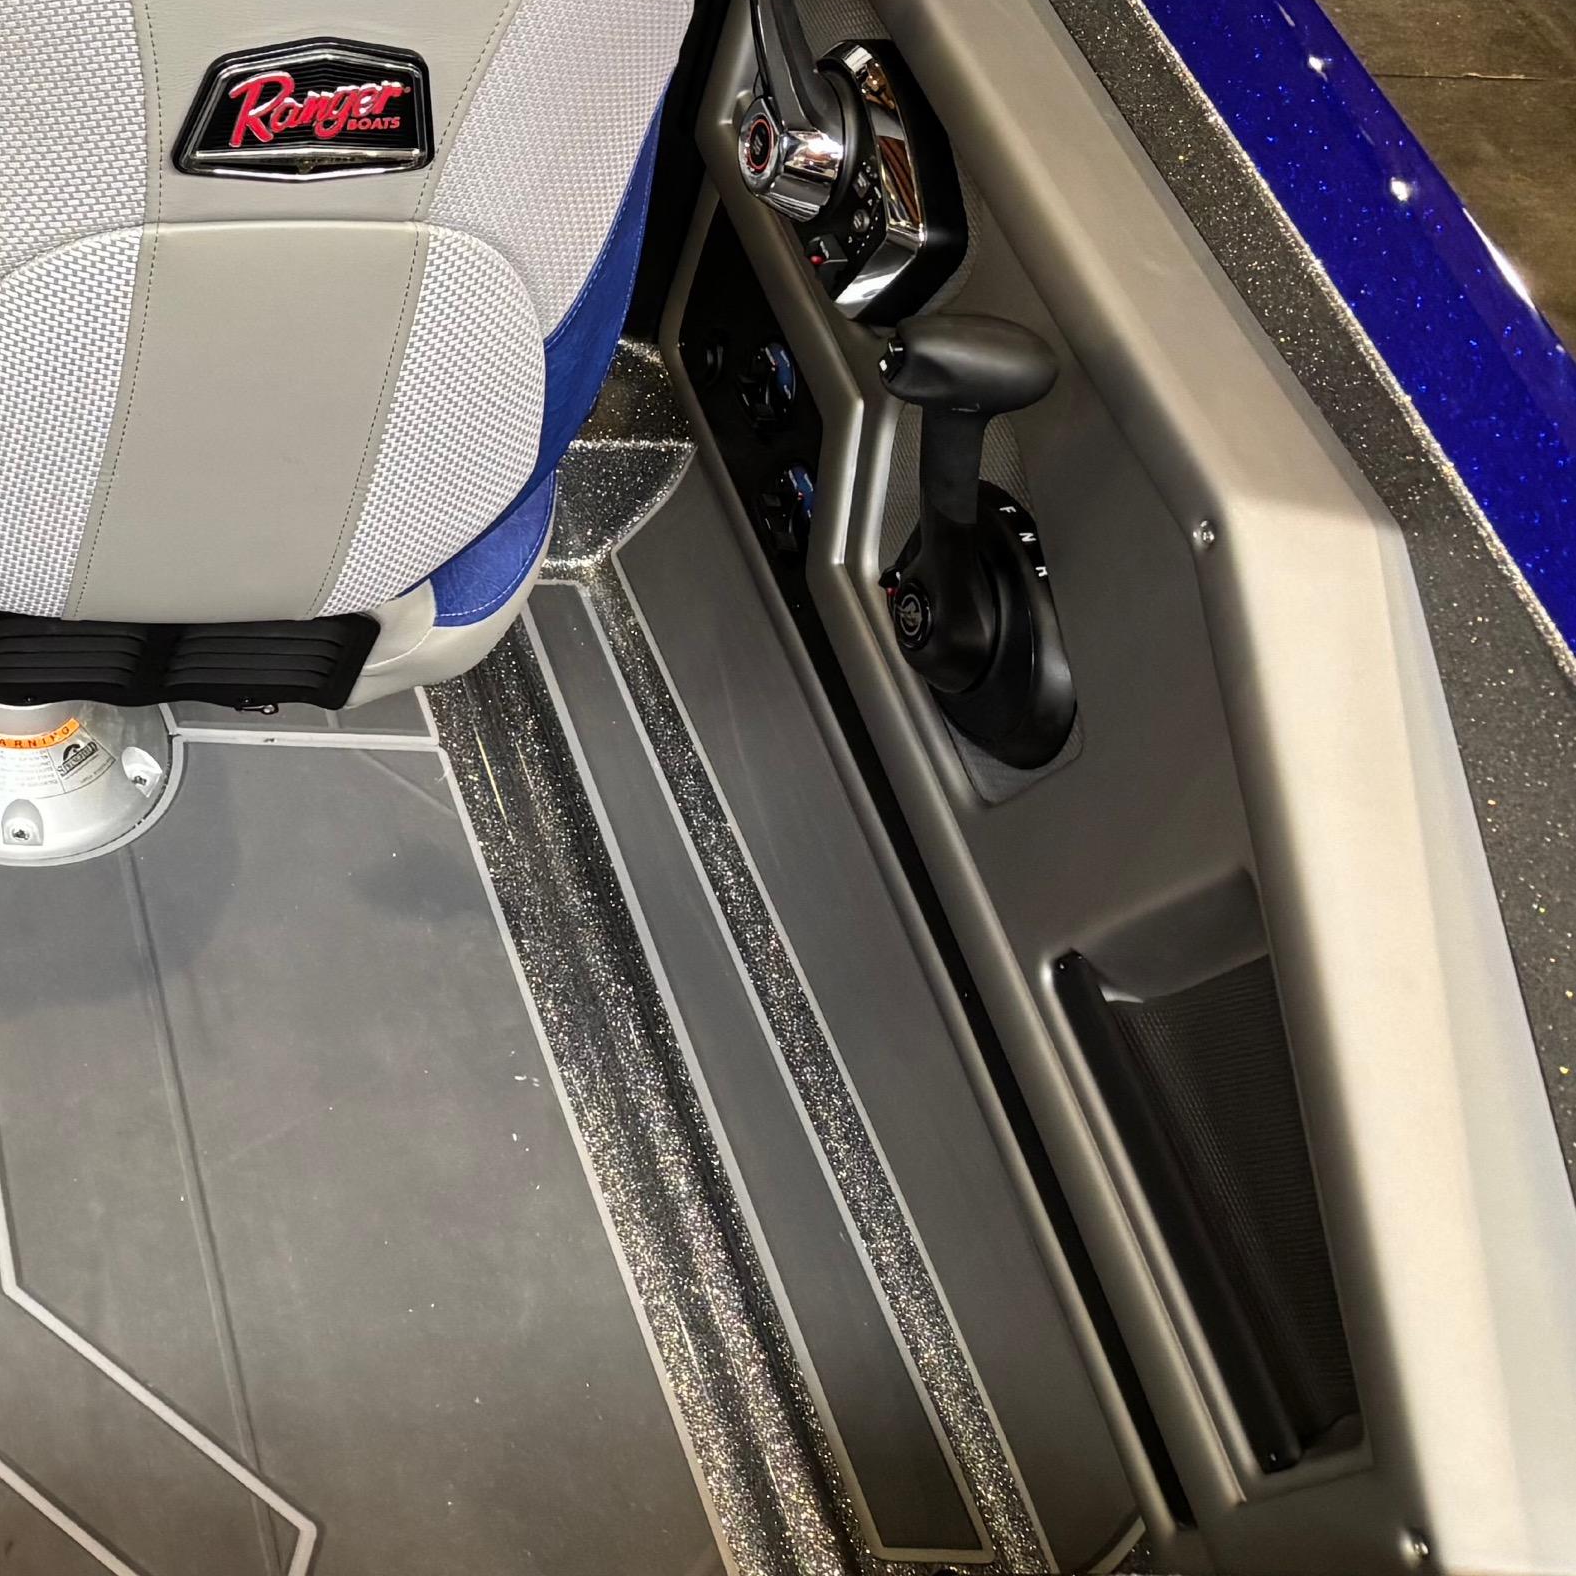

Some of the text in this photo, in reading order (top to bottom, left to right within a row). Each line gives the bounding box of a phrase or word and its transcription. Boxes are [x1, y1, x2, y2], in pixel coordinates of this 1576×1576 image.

[228, 70, 405, 148] Ranger
[346, 116, 401, 132] BOATS
[1018, 532, 1037, 542] N
